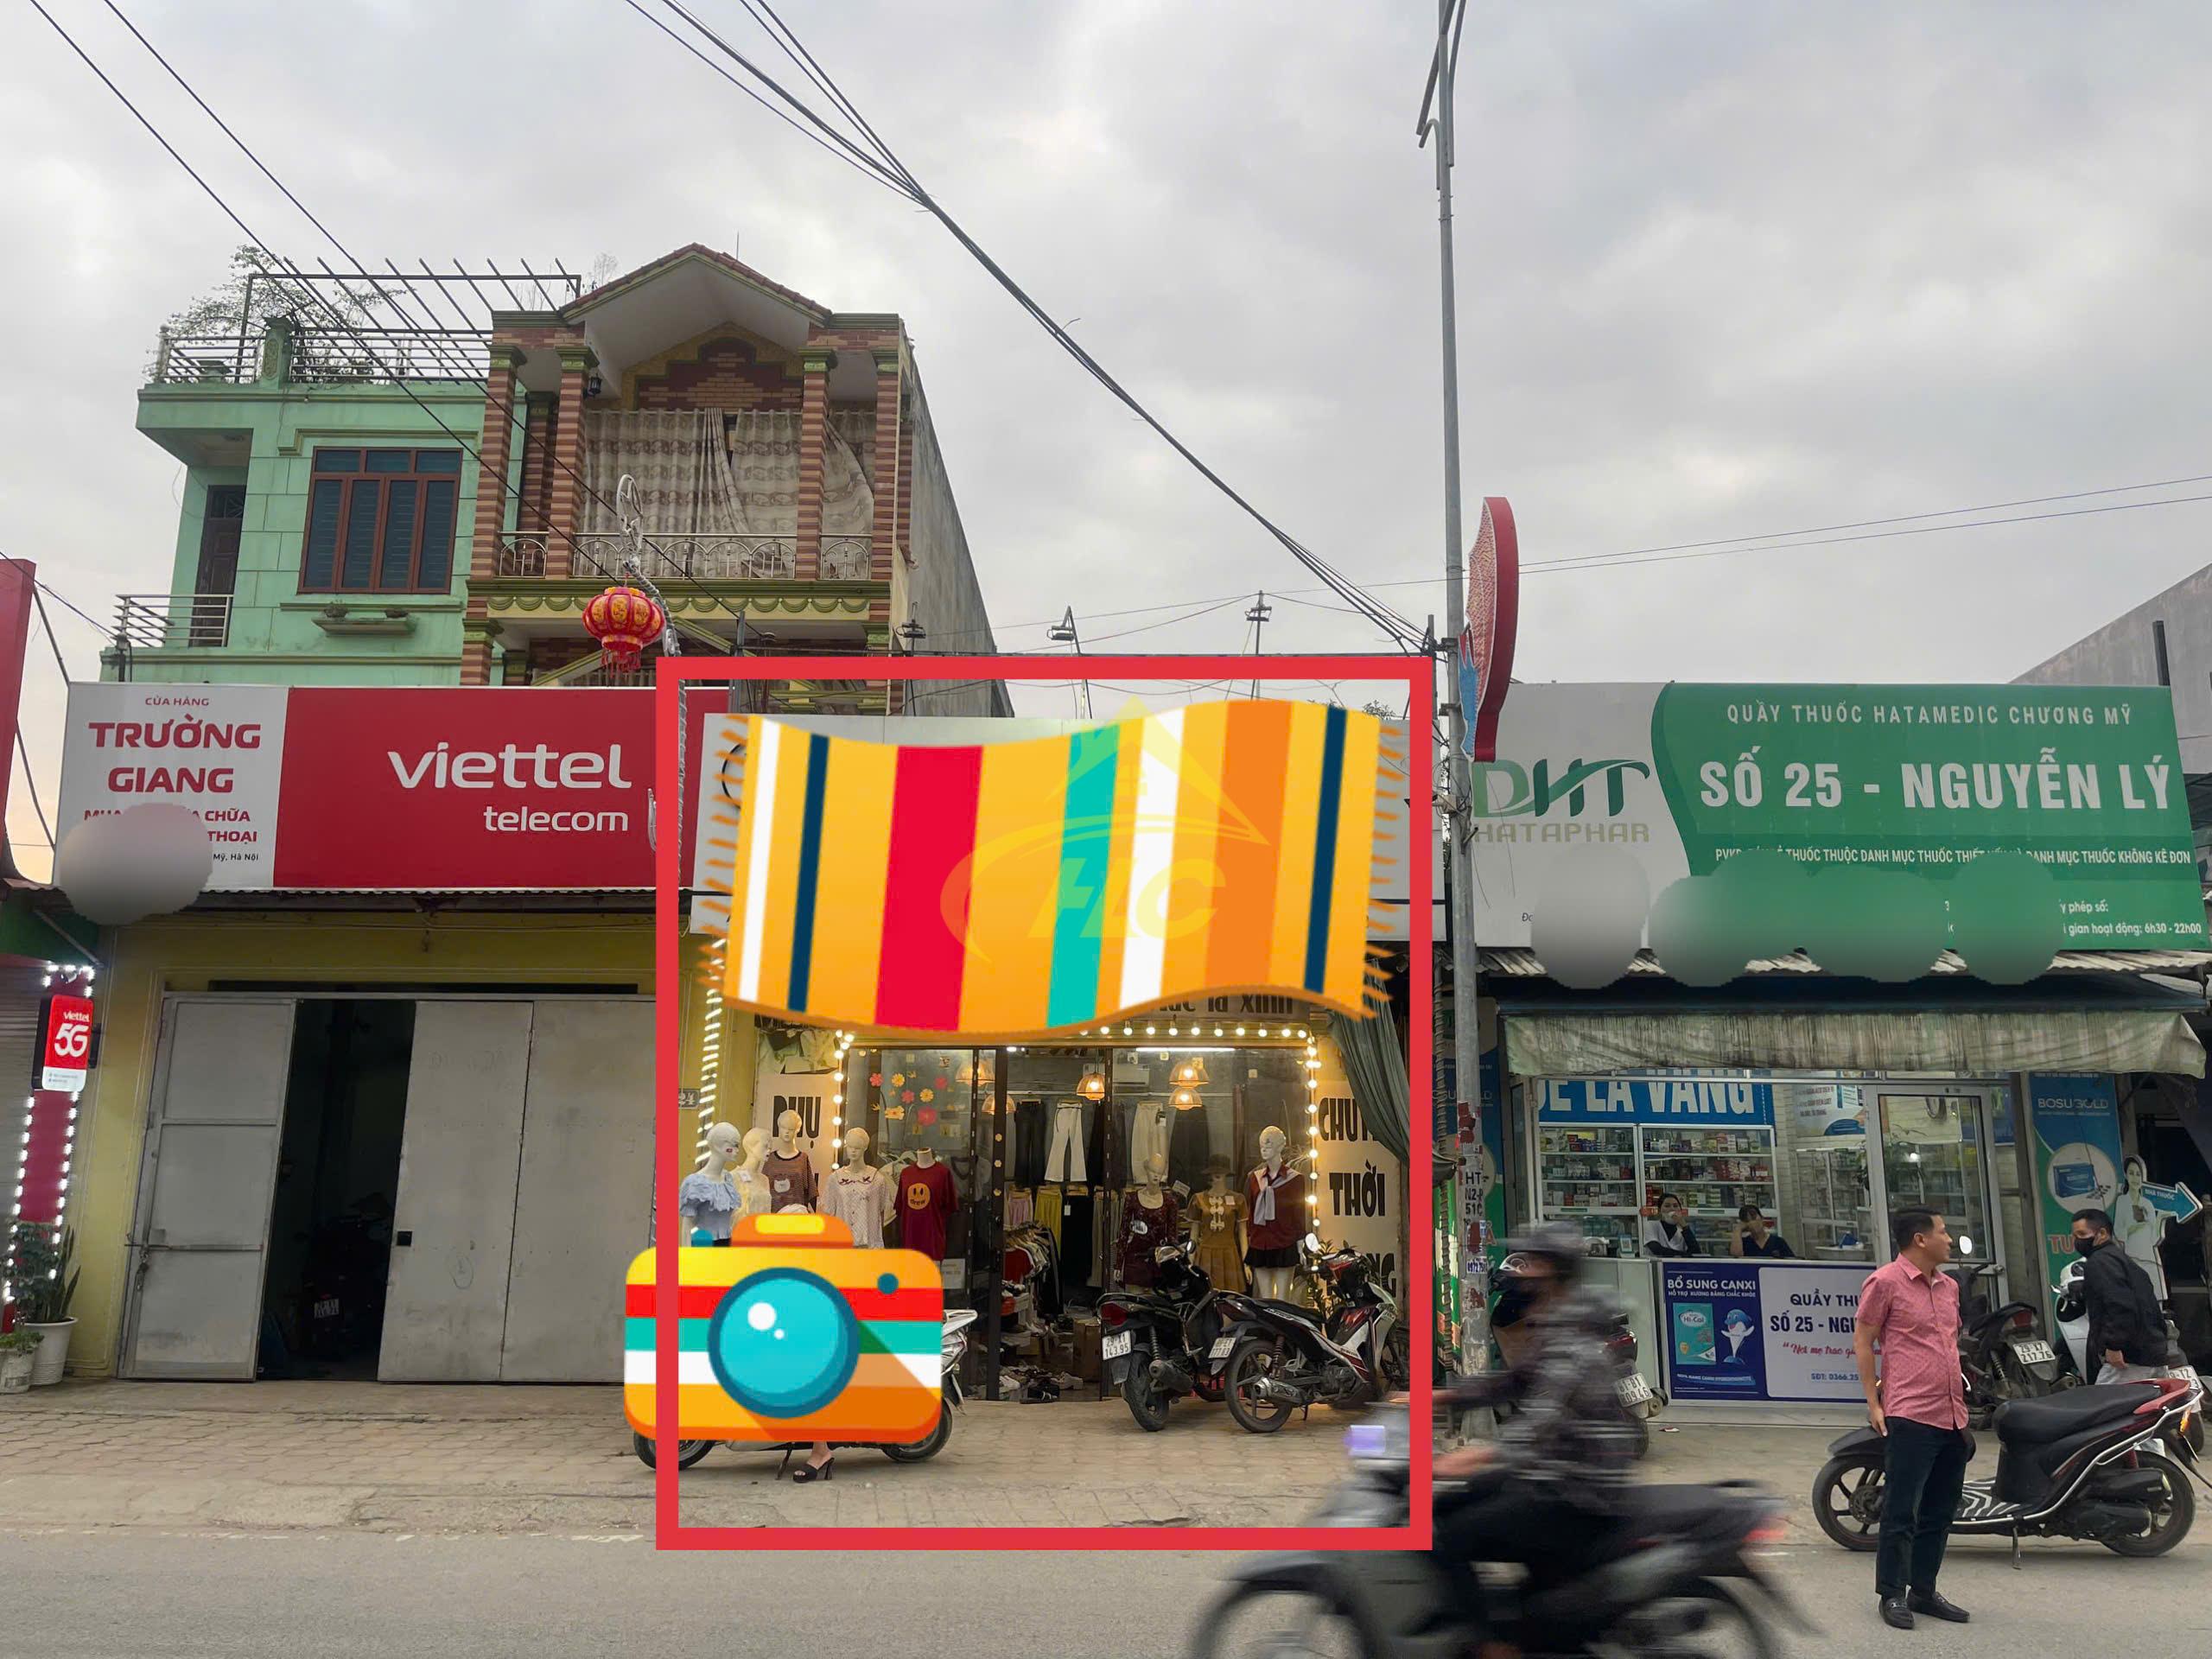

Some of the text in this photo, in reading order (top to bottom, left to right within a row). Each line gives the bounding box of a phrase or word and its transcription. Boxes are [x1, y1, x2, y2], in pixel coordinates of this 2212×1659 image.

[1727, 699, 2131, 725] QUẦY THUỐC HATAMEDIC CHƯƠNG MỸ
[88, 713, 261, 749] TRƯỜNG
[387, 741, 632, 789] viettel
[1700, 745, 1764, 808] SỐ
[1783, 763, 1841, 808] 25
[1901, 747, 2101, 810] NGUYỄN
[2119, 754, 2170, 810] LÝ
[108, 766, 234, 793] GIANG
[483, 805, 628, 832] telecom
[207, 830, 258, 845] THOẠI
[1474, 823, 1649, 843] HATAPHAR
[1860, 849, 1889, 862] DANH
[1891, 849, 1916, 865] MỤC
[1918, 845, 1953, 863] THUỐC
[2056, 850, 2080, 866] MỤC
[2082, 848, 2116, 864] THUỐC
[2117, 849, 2153, 864] KHÔNG
[63, 1011, 90, 1022] viettel
[54, 1023, 89, 1058] 5G
[1329, 1159, 1386, 1217] THỜI
[1668, 1275, 1756, 1290] BỔ SUNG CANXI
[1770, 1310, 1790, 1332] SỐ
[1795, 1316, 1814, 1332] 25
